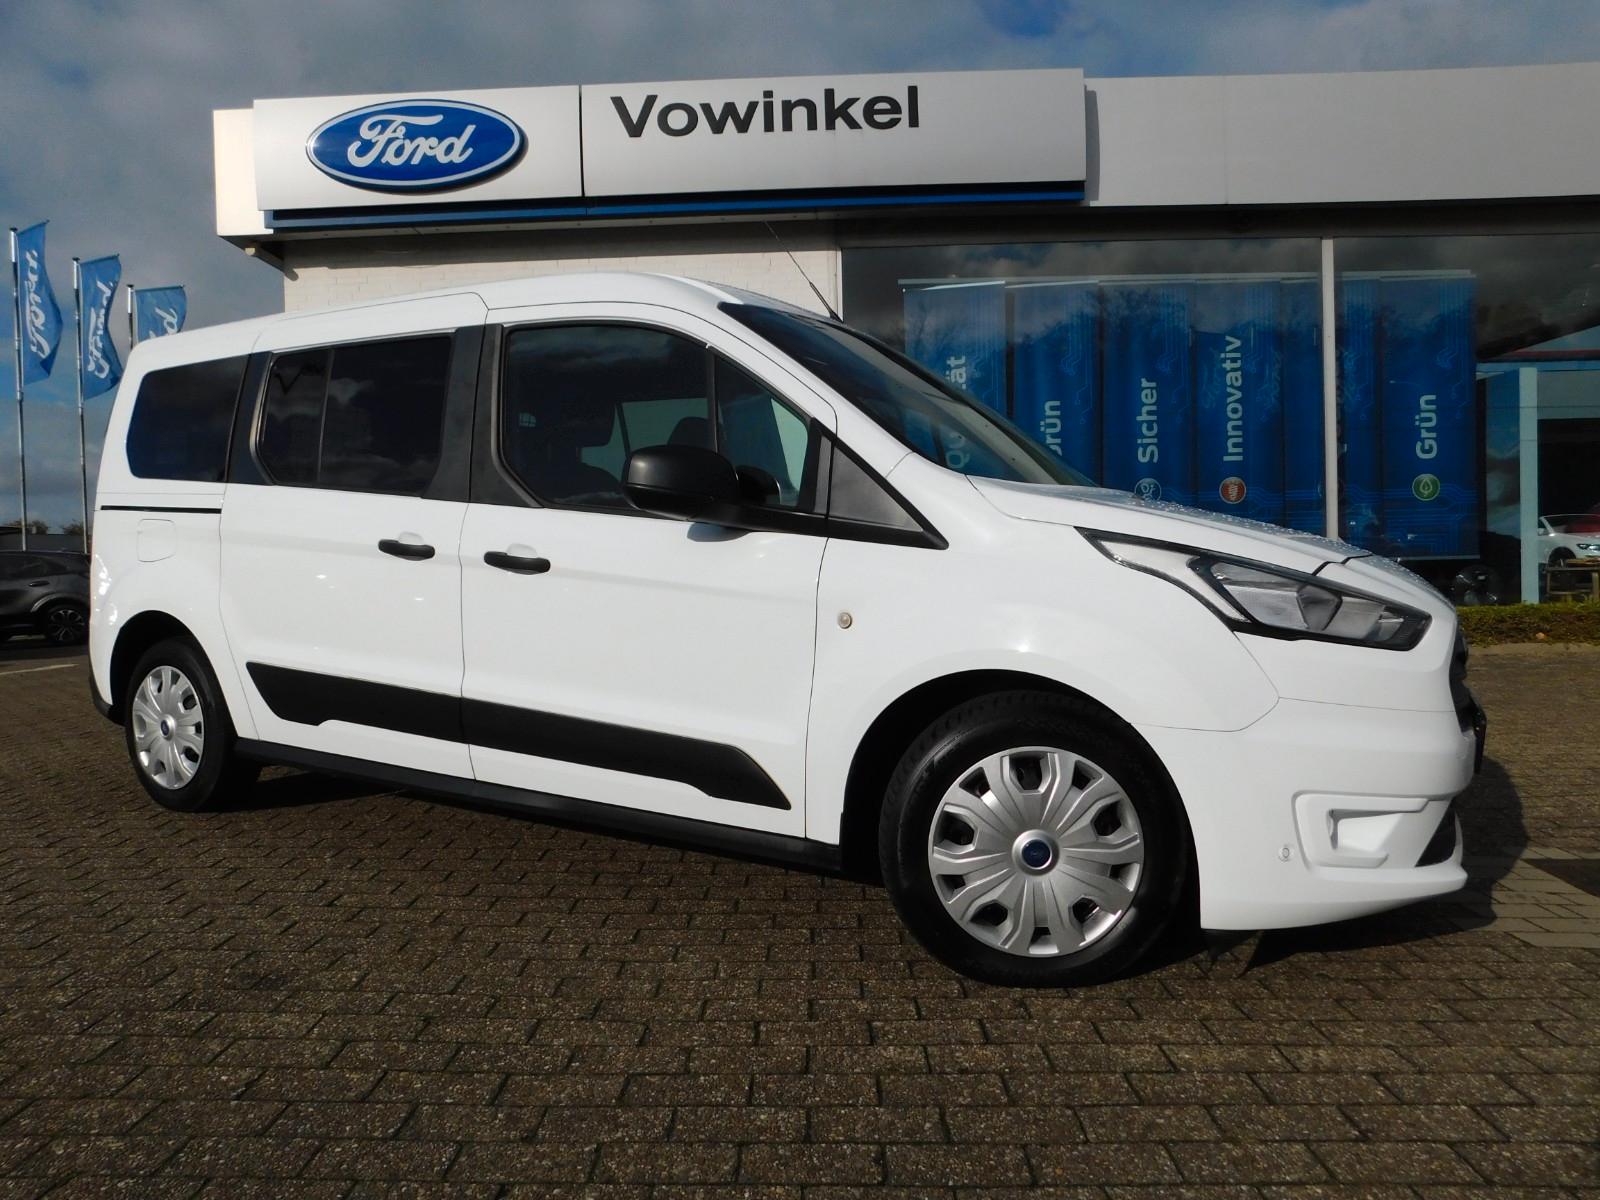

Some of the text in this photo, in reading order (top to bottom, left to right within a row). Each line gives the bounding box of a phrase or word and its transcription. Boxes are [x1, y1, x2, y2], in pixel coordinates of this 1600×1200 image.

[347, 113, 477, 168] Ford
[609, 85, 920, 138] Vowinkel
[1040, 400, 1063, 457] rün
[1136, 377, 1159, 464] Sicher
[1220, 335, 1244, 462] Innovativ
[1414, 394, 1438, 460] Grün
